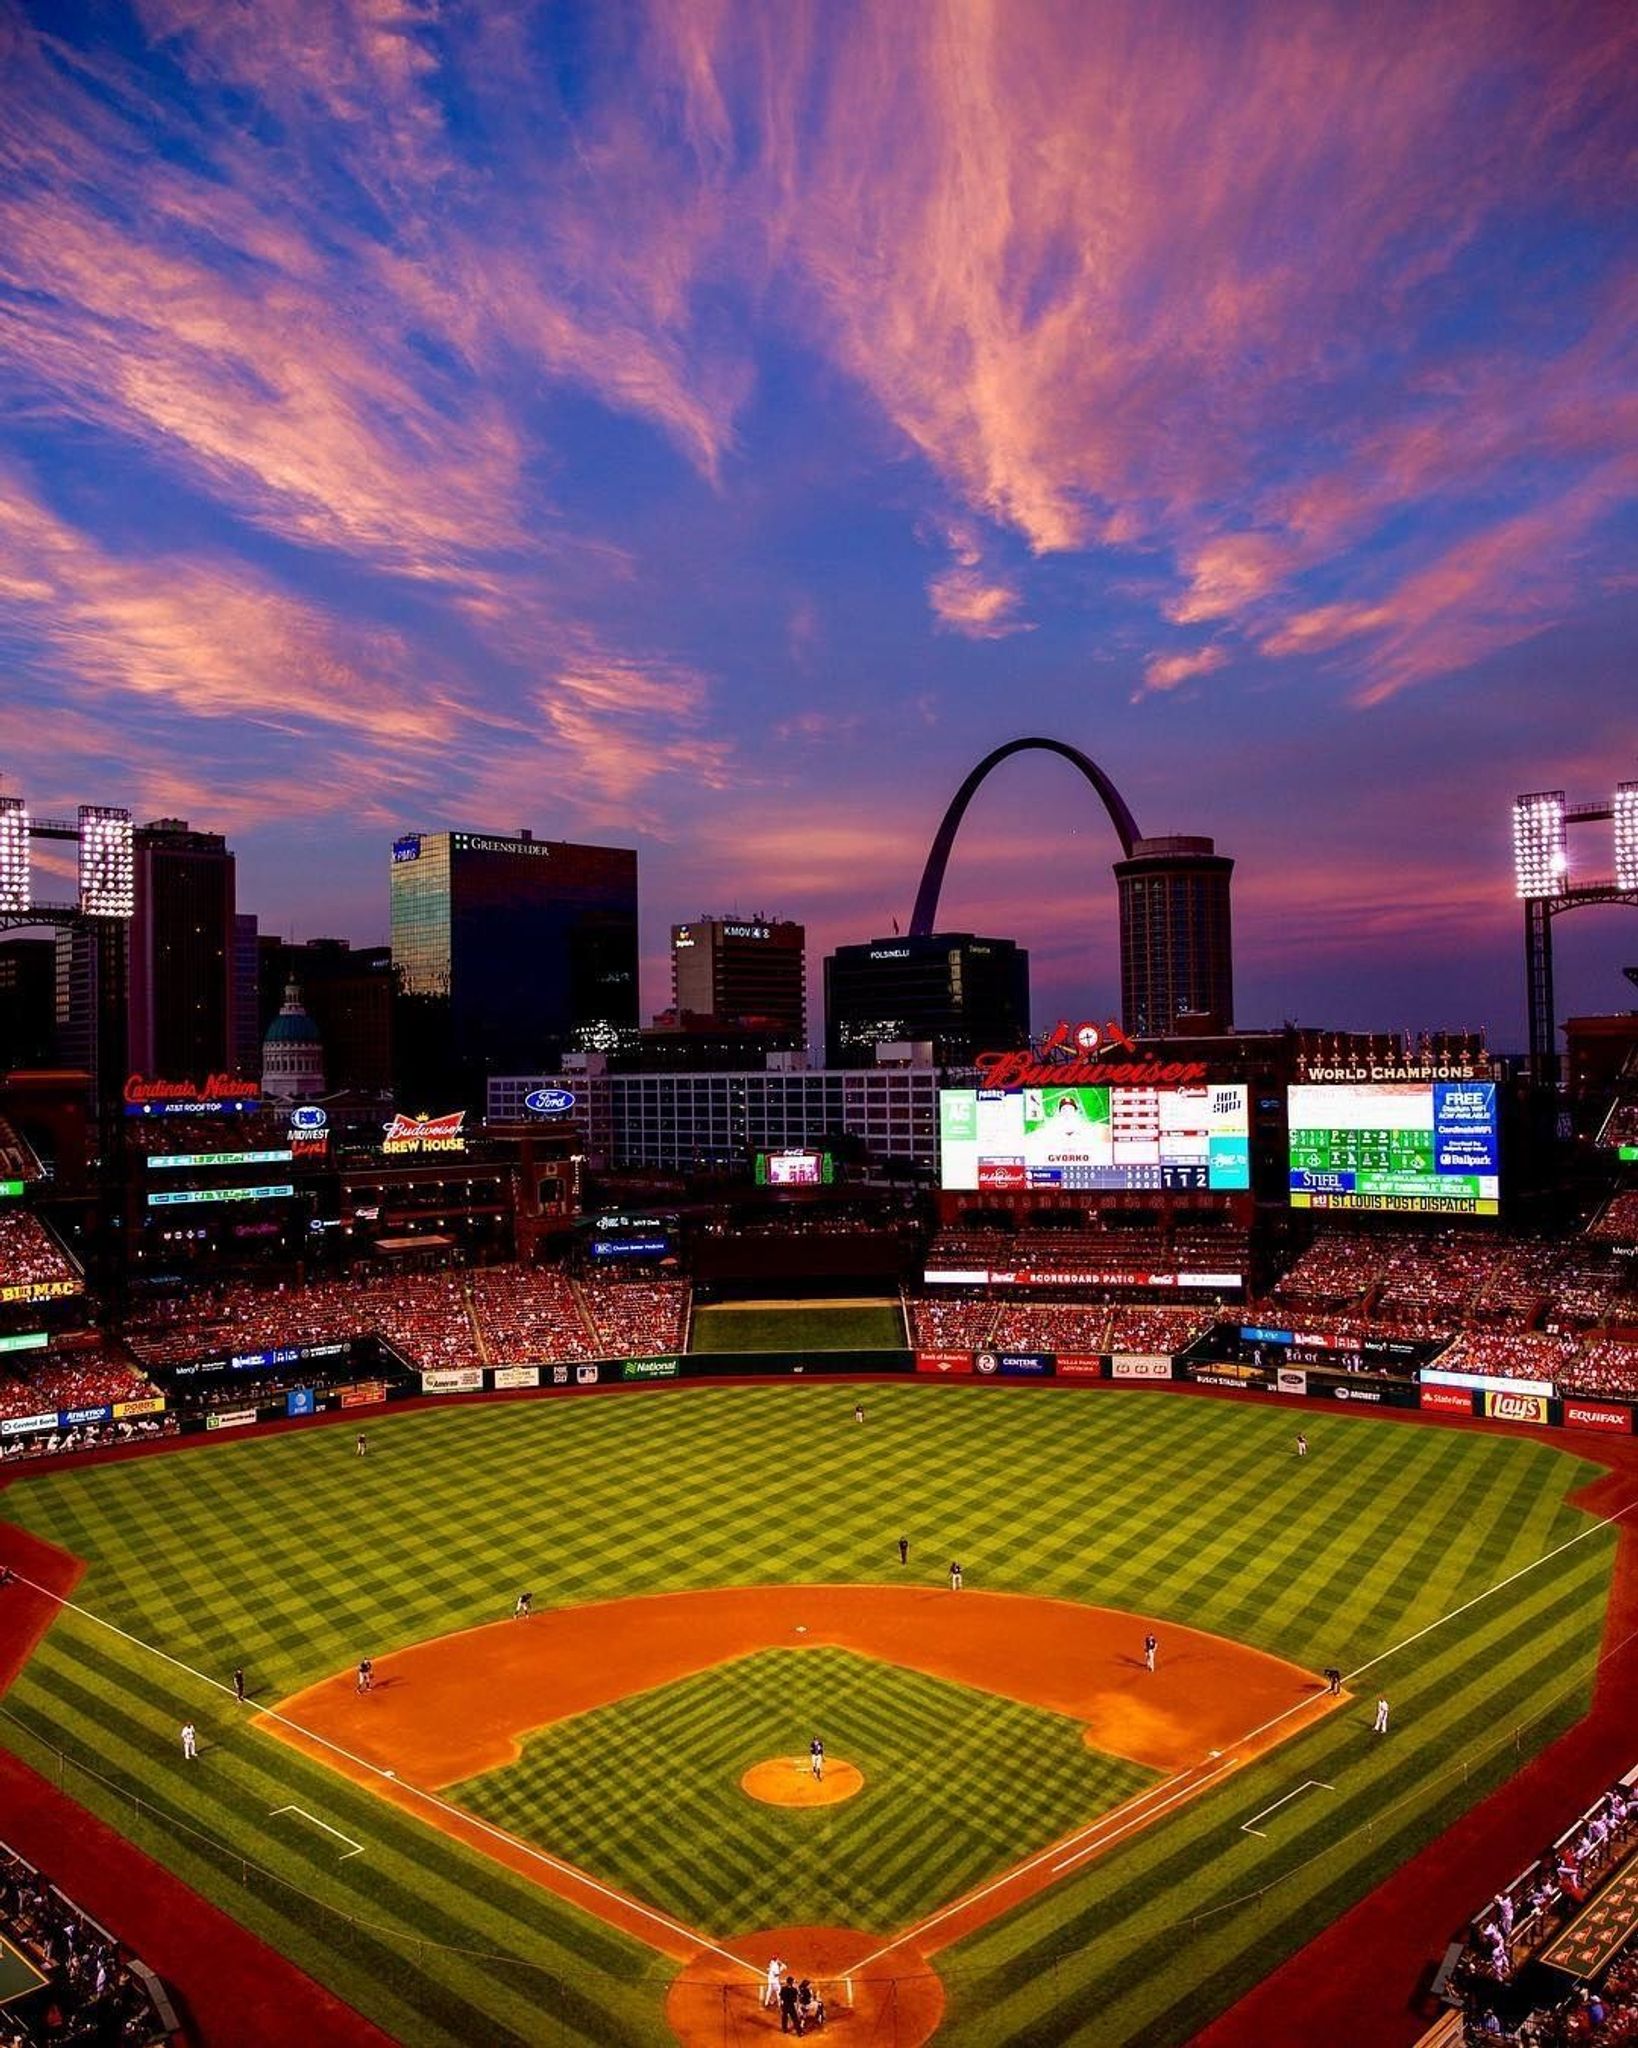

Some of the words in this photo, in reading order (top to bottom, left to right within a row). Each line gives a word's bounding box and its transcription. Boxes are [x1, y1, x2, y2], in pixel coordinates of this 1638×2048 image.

[471, 837, 549, 856] GREENSFELDER
[724, 926, 750, 937] KMOV
[870, 949, 910, 959] POLSINELLI
[976, 1051, 1207, 1088] Budweiser
[1308, 1068, 1367, 1080] WORLD
[1371, 1066, 1474, 1080] CHAMPIONS
[124, 1074, 196, 1102] Cardinals
[197, 1073, 258, 1101] Nation
[536, 1092, 566, 1107] Ford
[1217, 1091, 1237, 1102] HOT
[1446, 1092, 1483, 1105] FREE
[184, 1103, 222, 1112] ROOFTOP
[1212, 1100, 1241, 1113] SHOT
[286, 1129, 330, 1141] MIDWEST
[382, 1122, 463, 1139] Budweiser
[383, 1139, 419, 1154] BREW
[423, 1138, 466, 1152] HOUSE
[1048, 1154, 1089, 1162] GYORKO
[1452, 1154, 1491, 1166] Ballpark
[1163, 1174, 1172, 1187] 1
[1179, 1174, 1188, 1187] 1
[1196, 1174, 1207, 1187] 2
[1350, 1195, 1382, 1209] LOUIS
[1030, 1274, 1100, 1283] SCOREBOARD
[1103, 1275, 1135, 1284] PATIO
[34, 1282, 74, 1296] MAC
[1365, 1342, 1384, 1351] Mercy
[637, 1361, 676, 1373] National
[1002, 1358, 1038, 1367] CENTENE
[1196, 1375, 1218, 1384] BUSCH
[1219, 1377, 1247, 1388] STADIUM
[1350, 1391, 1381, 1401] MIDWEST
[66, 1408, 106, 1420] ATHLETICO
[1568, 1409, 1625, 1424] EQUIFAX
[13, 1419, 38, 1430] Central
[39, 1416, 57, 1426] Bank
